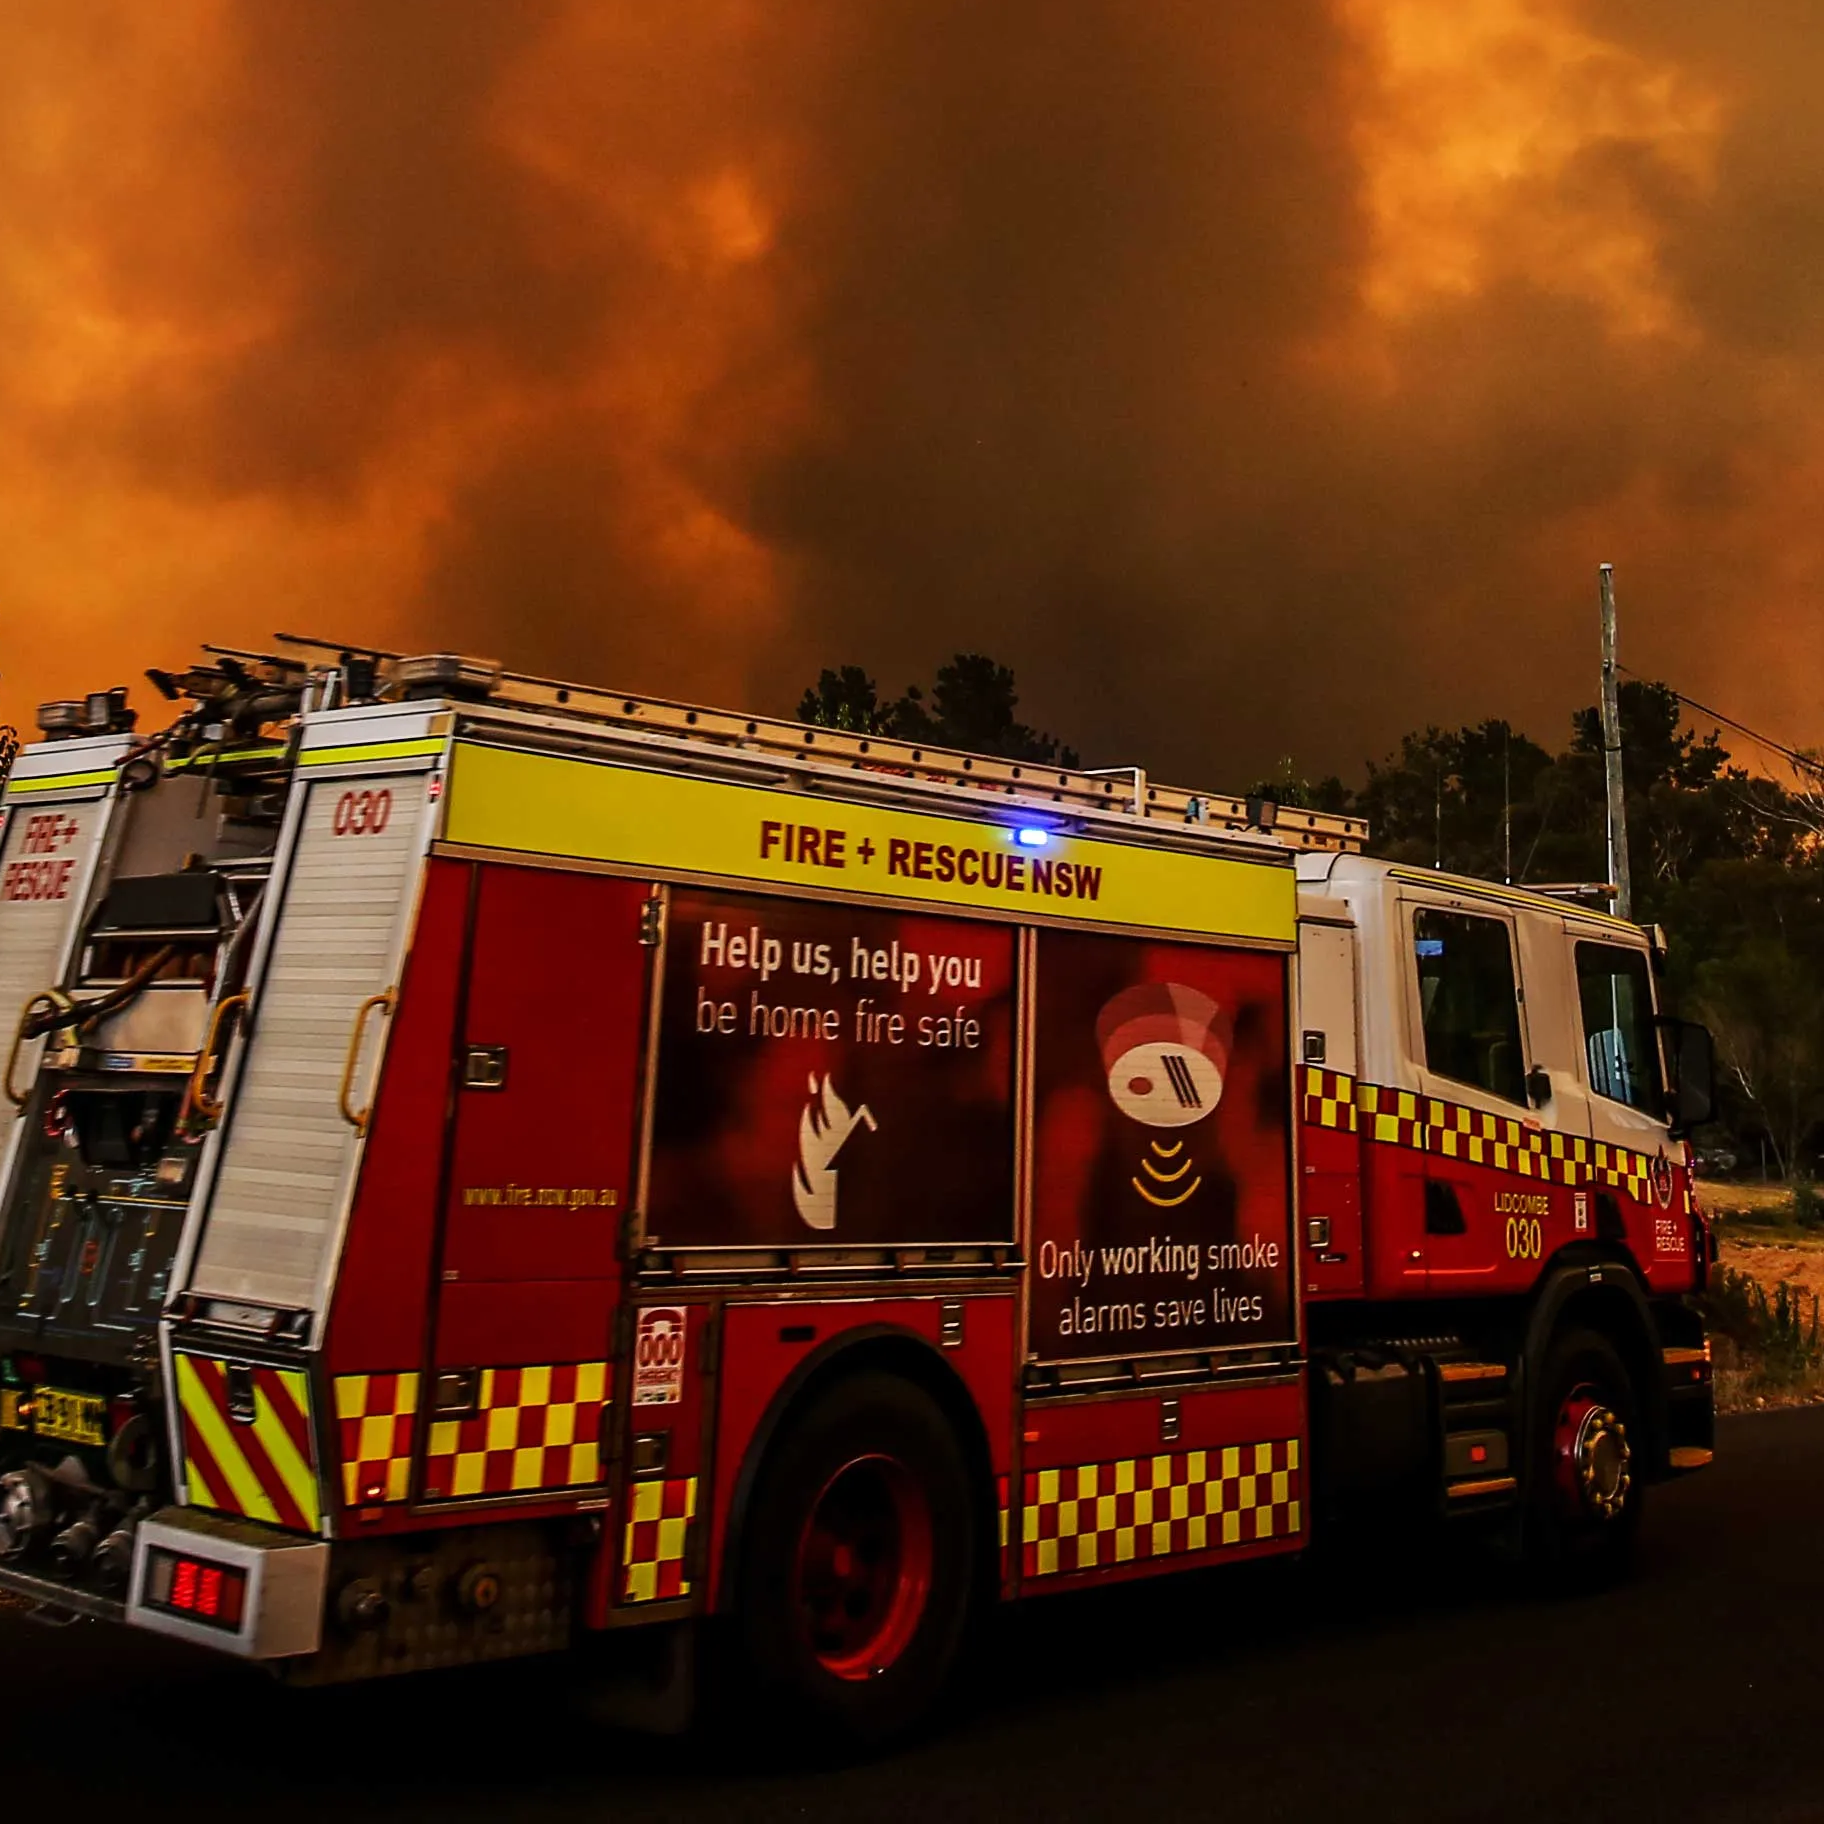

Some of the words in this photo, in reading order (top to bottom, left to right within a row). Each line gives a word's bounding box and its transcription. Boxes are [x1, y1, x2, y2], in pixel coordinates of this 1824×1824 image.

[333, 789, 393, 836] 030
[760, 820, 847, 869] FIRE
[887, 838, 1025, 892] RESCUE
[1031, 858, 1102, 901] NSW
[700, 921, 783, 982] Help
[792, 941, 841, 985] us,
[849, 936, 920, 993] help
[928, 953, 982, 995] you
[696, 985, 738, 1034] be
[749, 990, 841, 1041] home
[855, 998, 906, 1045] fire
[917, 1005, 981, 1049] safe
[1494, 1192, 1550, 1216] LIDCOMBE
[1039, 1240, 1095, 1288] Only
[1100, 1236, 1200, 1281] working
[1207, 1233, 1280, 1271] smoke
[1506, 1217, 1542, 1259] 030
[1058, 1296, 1148, 1336] alarms
[1153, 1298, 1206, 1329] save
[1212, 1287, 1263, 1325] lives
[639, 1333, 685, 1367] 000
